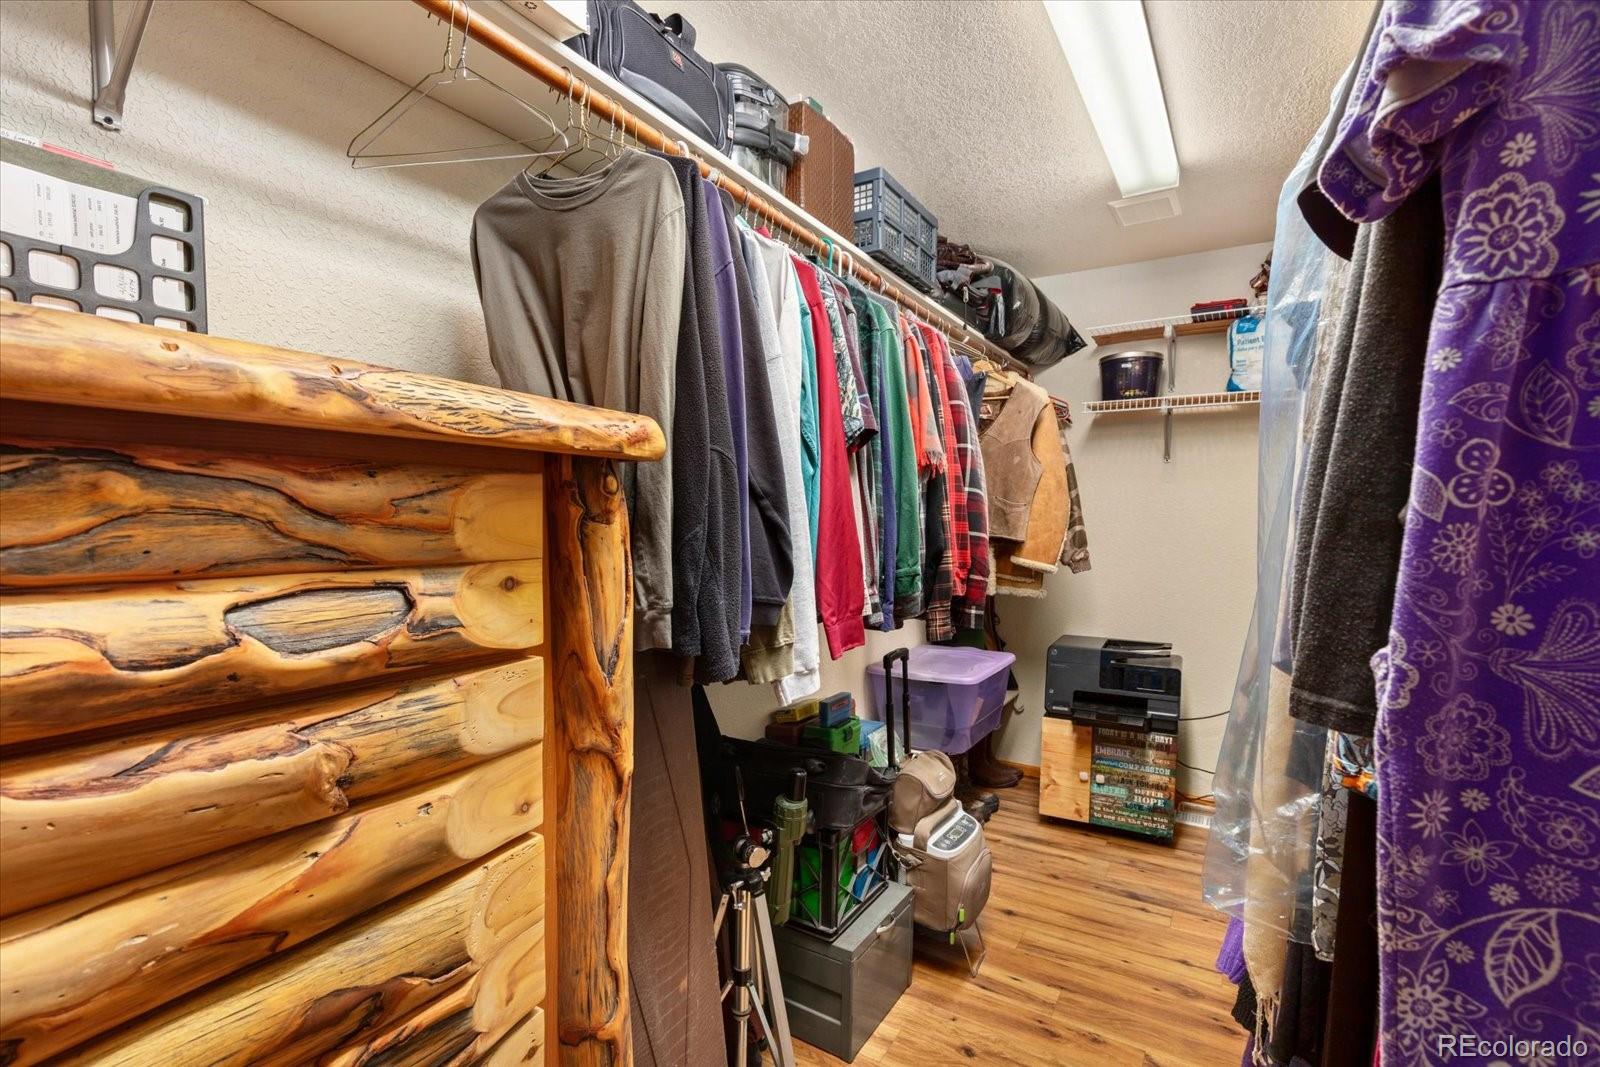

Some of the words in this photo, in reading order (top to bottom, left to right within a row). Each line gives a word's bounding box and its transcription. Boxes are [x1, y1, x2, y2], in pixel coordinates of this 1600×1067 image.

[1154, 735, 1173, 745] DAY!
[1095, 745, 1130, 758] EMBRACE
[1118, 761, 1171, 775] COMPASSION
[1135, 788, 1164, 799] OFFER
[1134, 796, 1165, 807] HOPE
